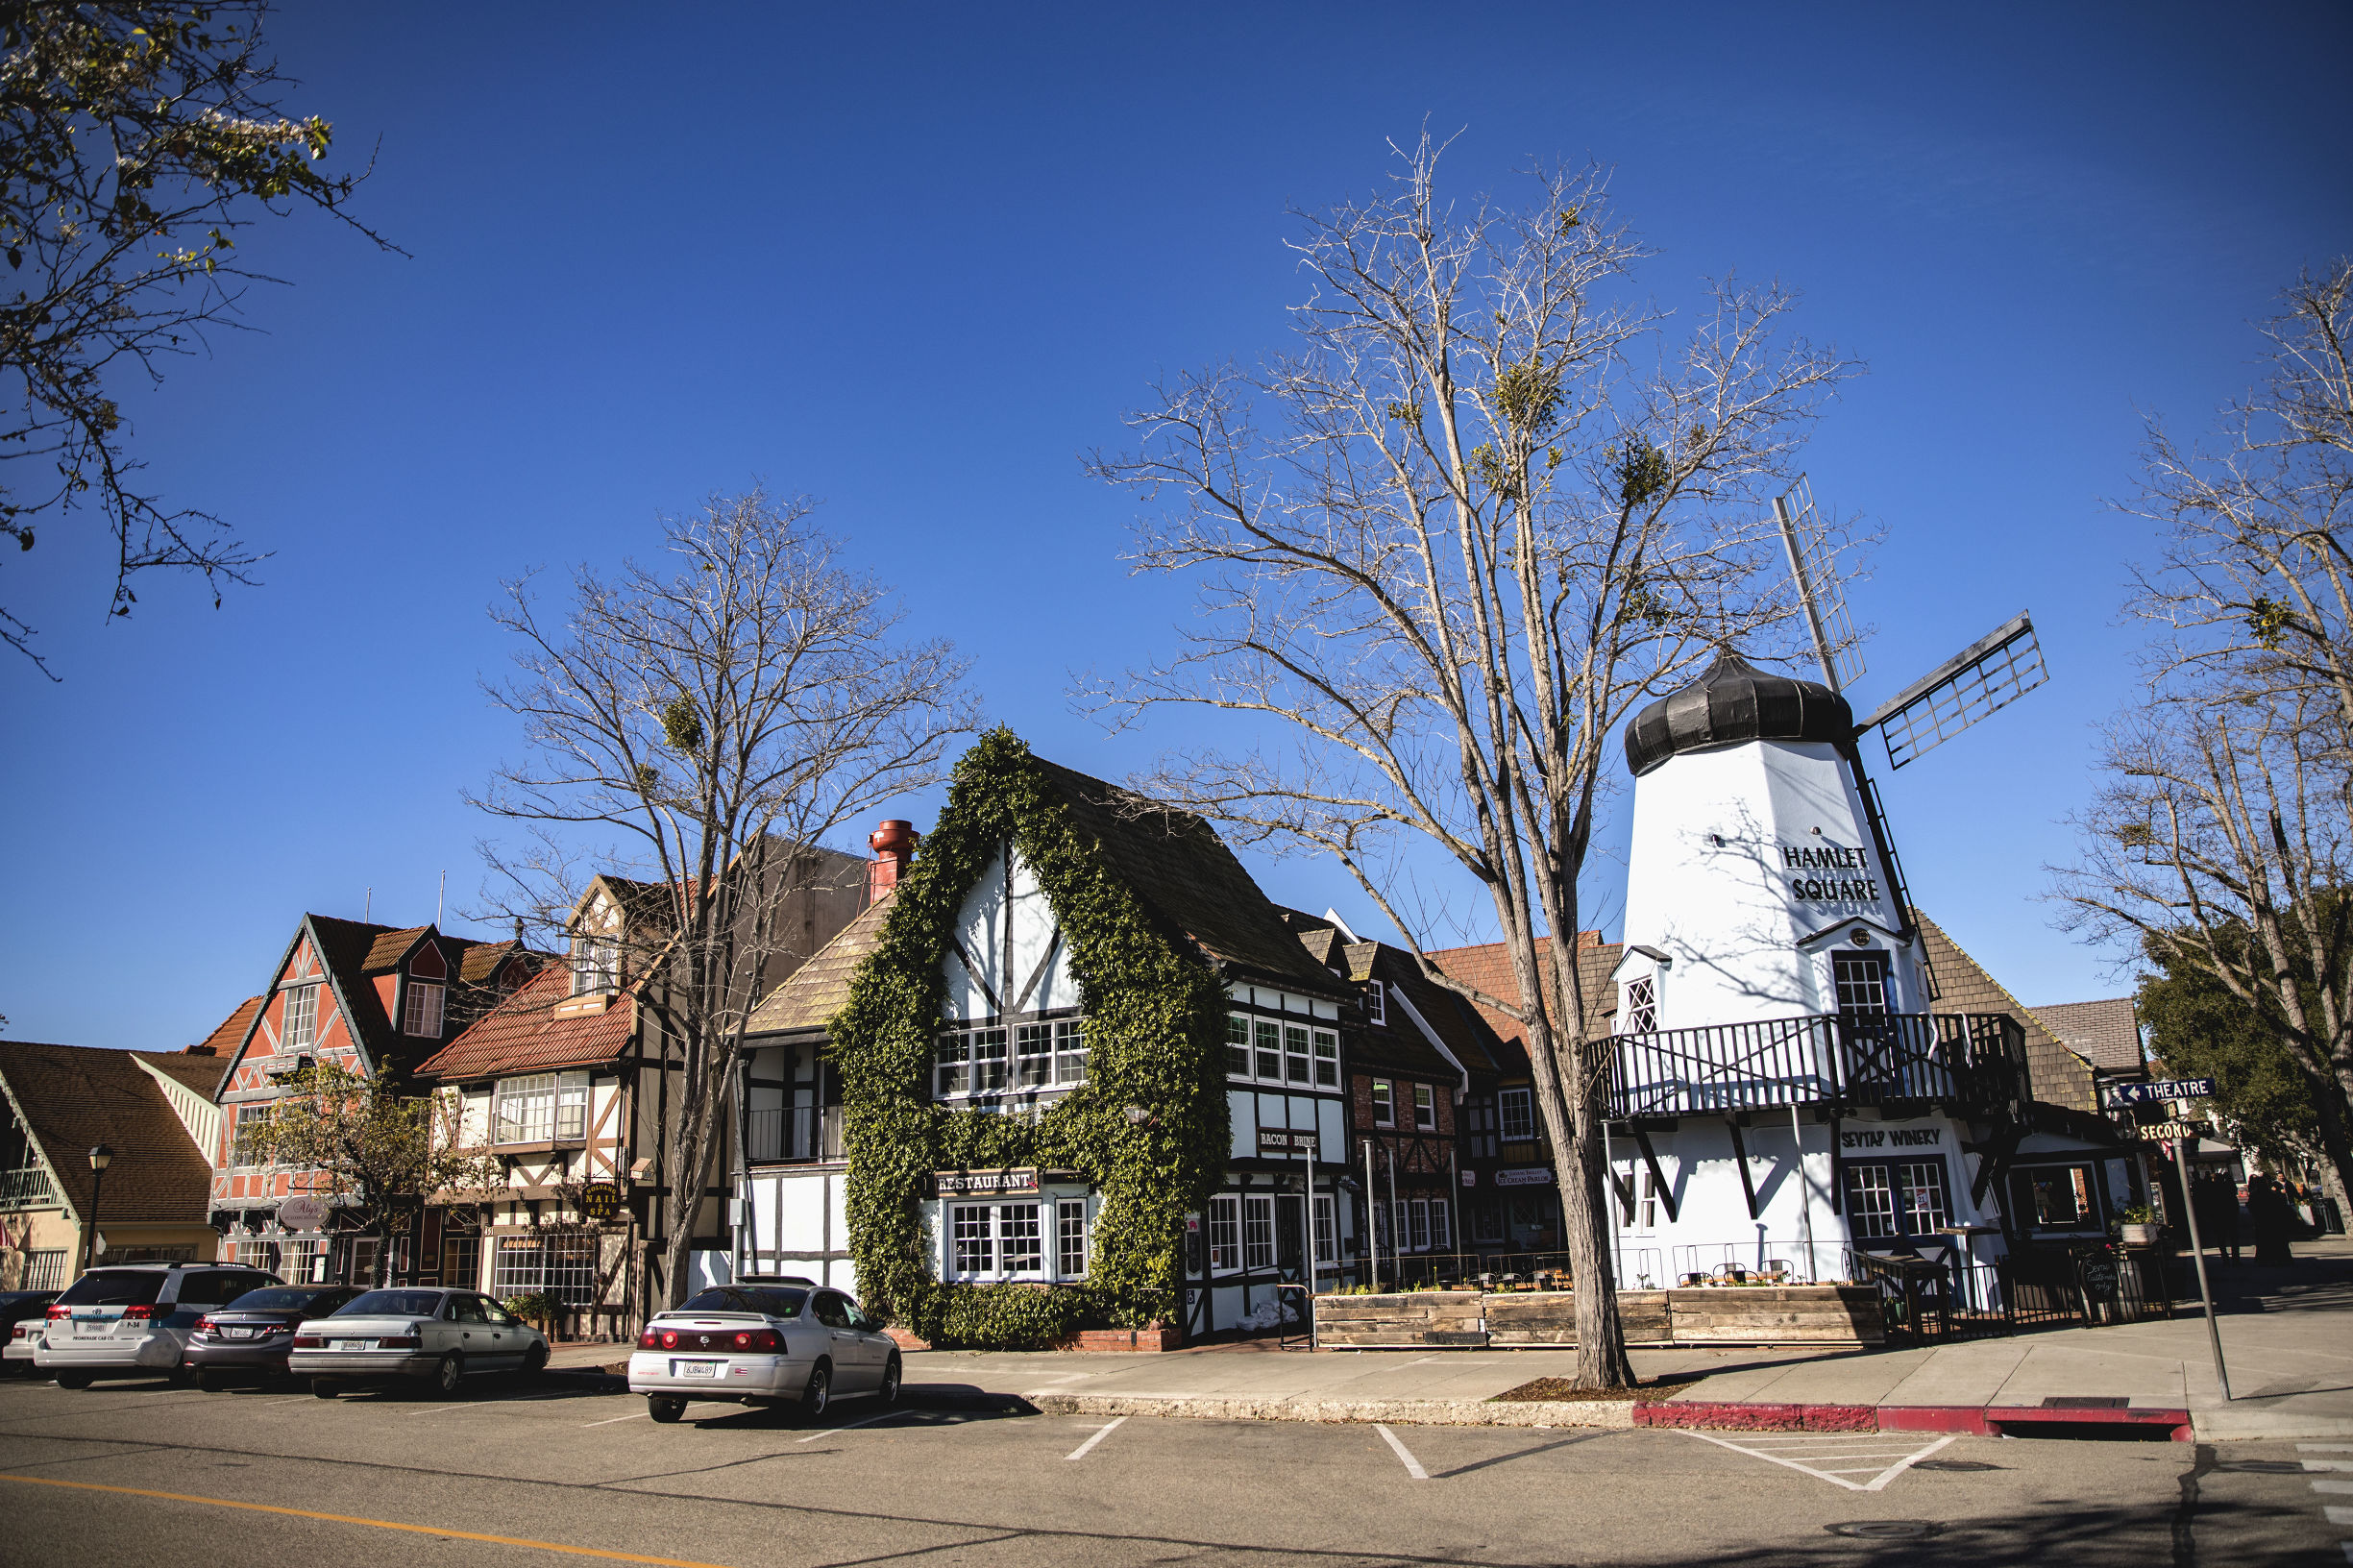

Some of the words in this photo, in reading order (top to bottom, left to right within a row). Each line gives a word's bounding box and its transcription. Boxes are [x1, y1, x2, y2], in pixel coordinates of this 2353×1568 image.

[1782, 846, 1867, 869] HAMLET
[1792, 878, 1880, 901] SQUARE
[2145, 1080, 2209, 1099] THEATRE
[1261, 1133, 1287, 1146] BACON
[1293, 1135, 1316, 1147] BRINE
[1841, 1129, 1885, 1148] SEVTAP
[1888, 1128, 1941, 1147] WINERY
[2140, 1123, 2192, 1140] SECOND
[586, 1185, 617, 1194] SOLVANG
[938, 1173, 1031, 1190] RESTAURANT
[586, 1194, 618, 1203] NAIL
[293, 1200, 319, 1215] Aly's
